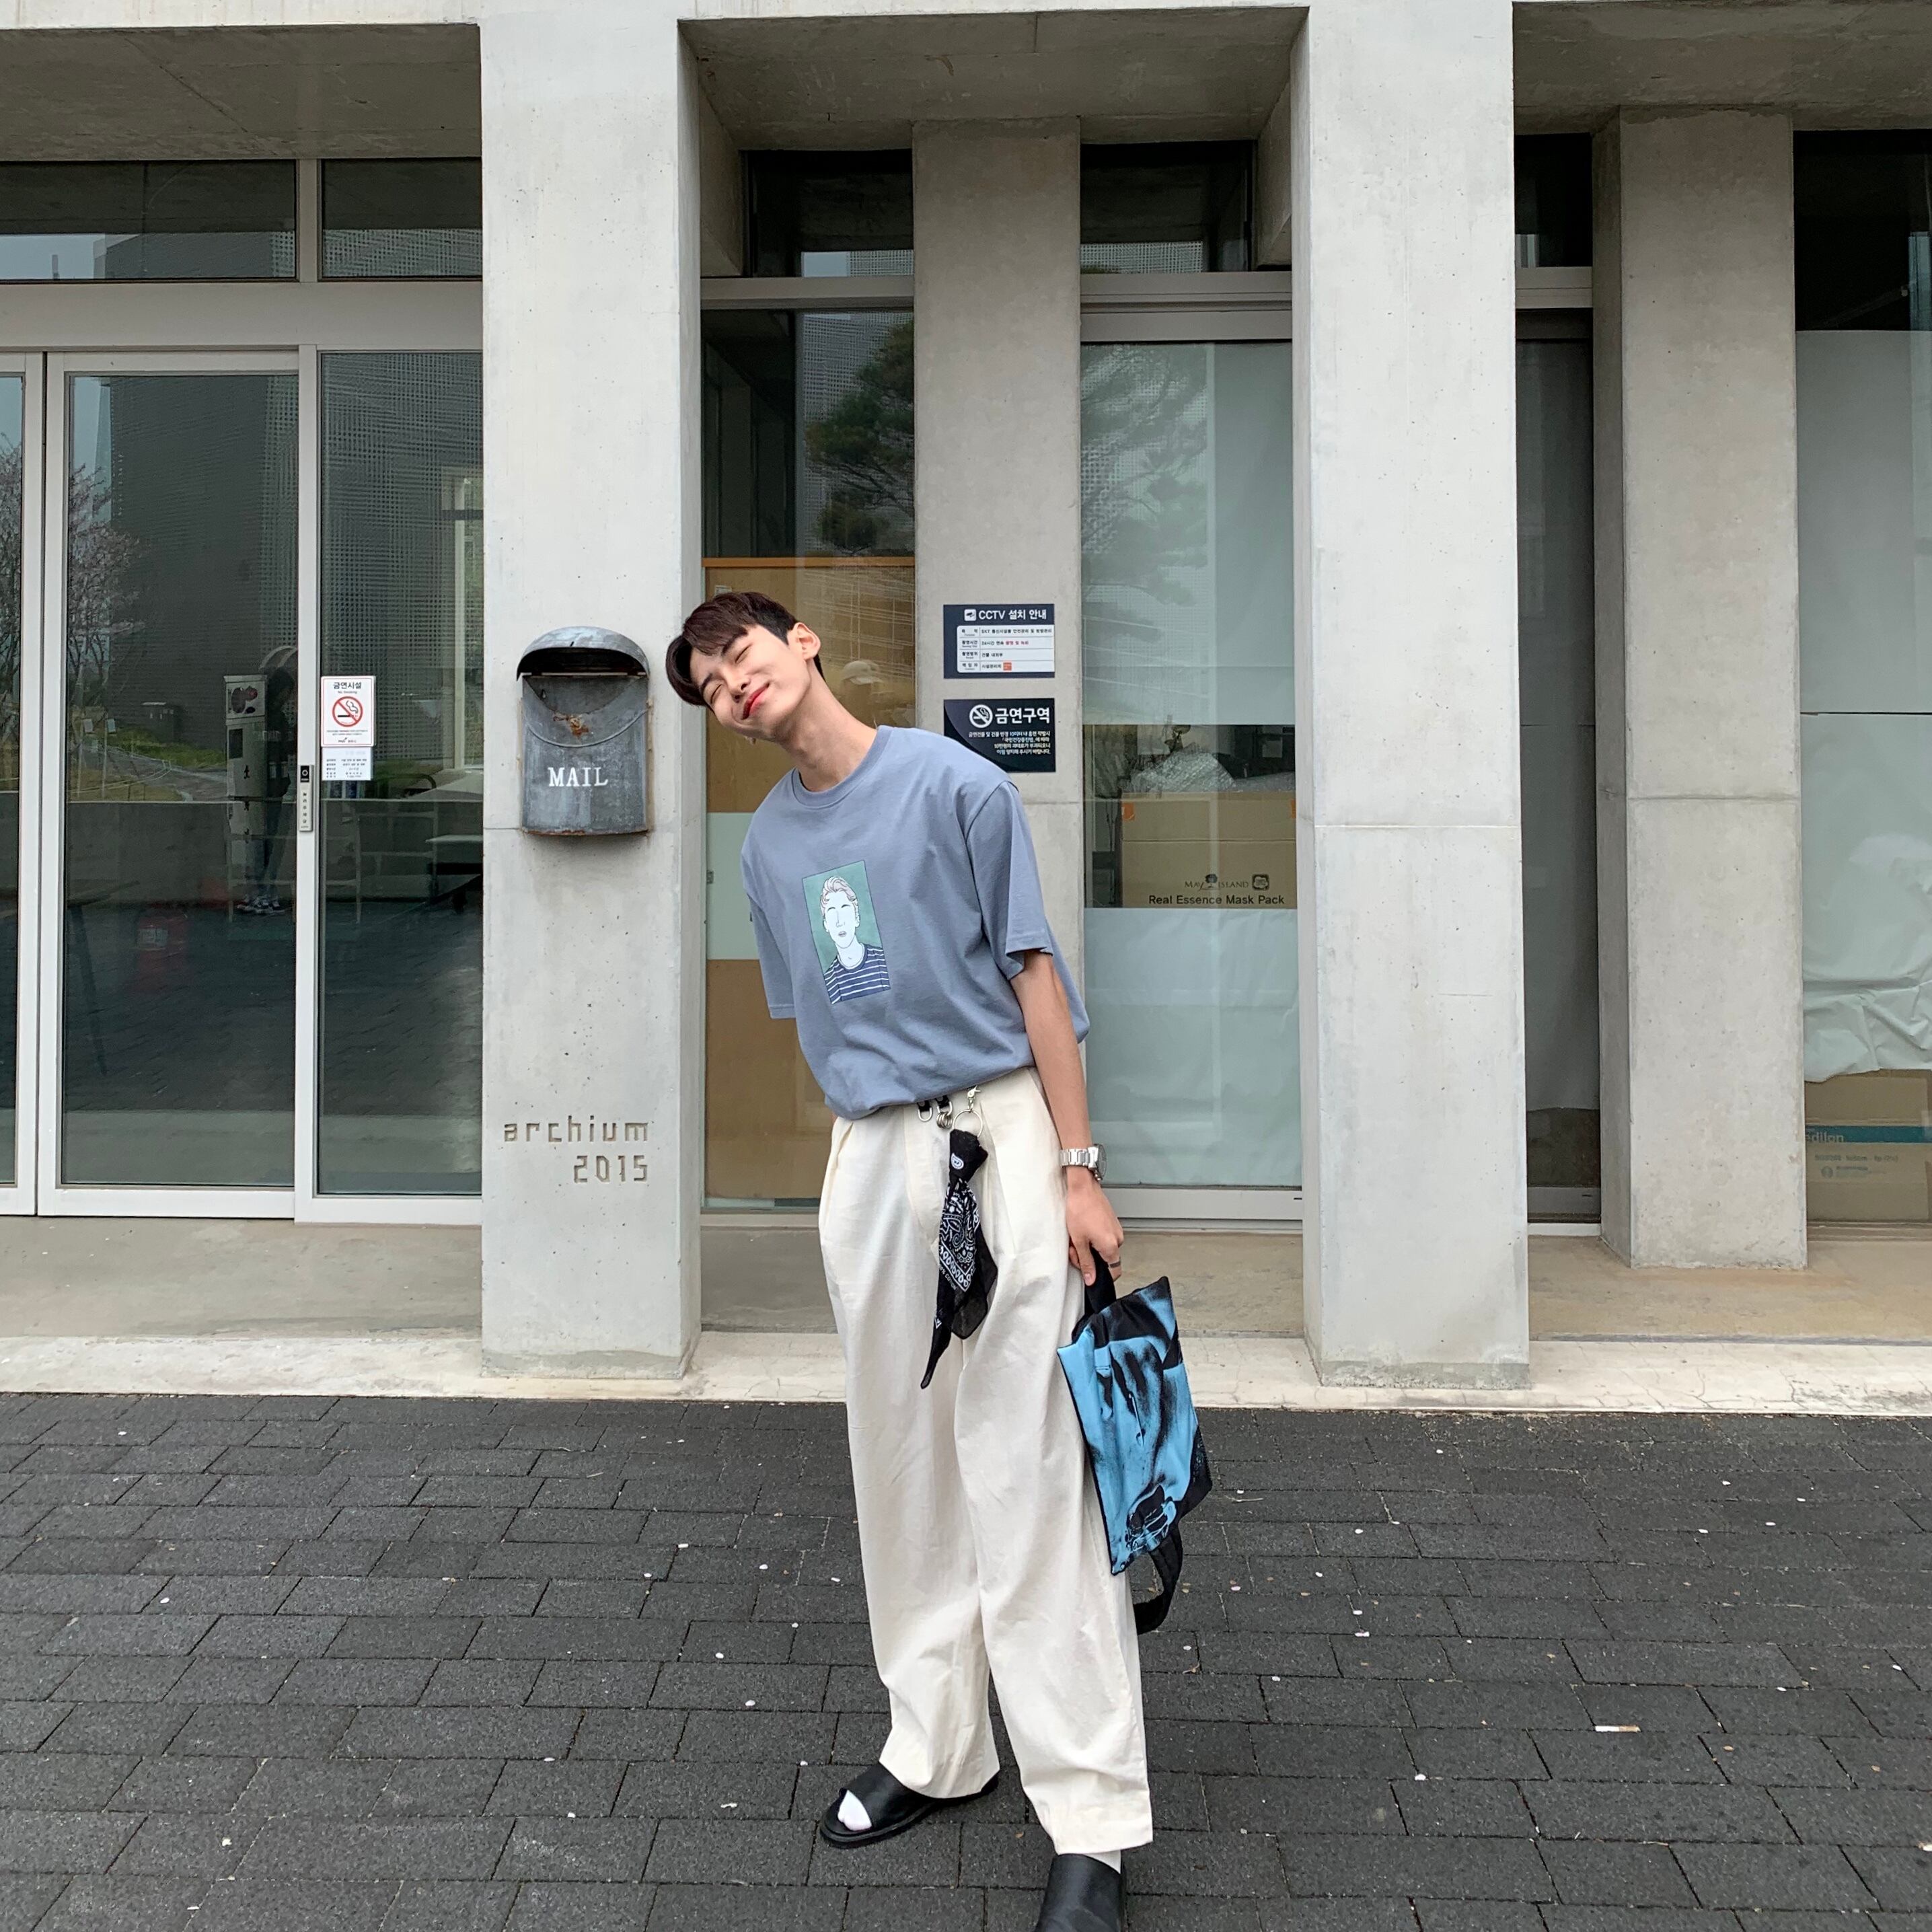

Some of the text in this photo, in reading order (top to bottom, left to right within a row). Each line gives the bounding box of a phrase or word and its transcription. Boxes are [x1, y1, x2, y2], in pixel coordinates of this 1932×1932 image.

[979, 609, 1047, 620] CCTV 설치 안내
[333, 681, 362, 690] 금연시설
[995, 707, 1050, 724] 금연구역
[548, 767, 609, 786] MAIL
[1149, 895, 1285, 905] Real Essence Mask Pack
[504, 1115, 648, 1143] archium
[573, 1154, 648, 1183] 2015
